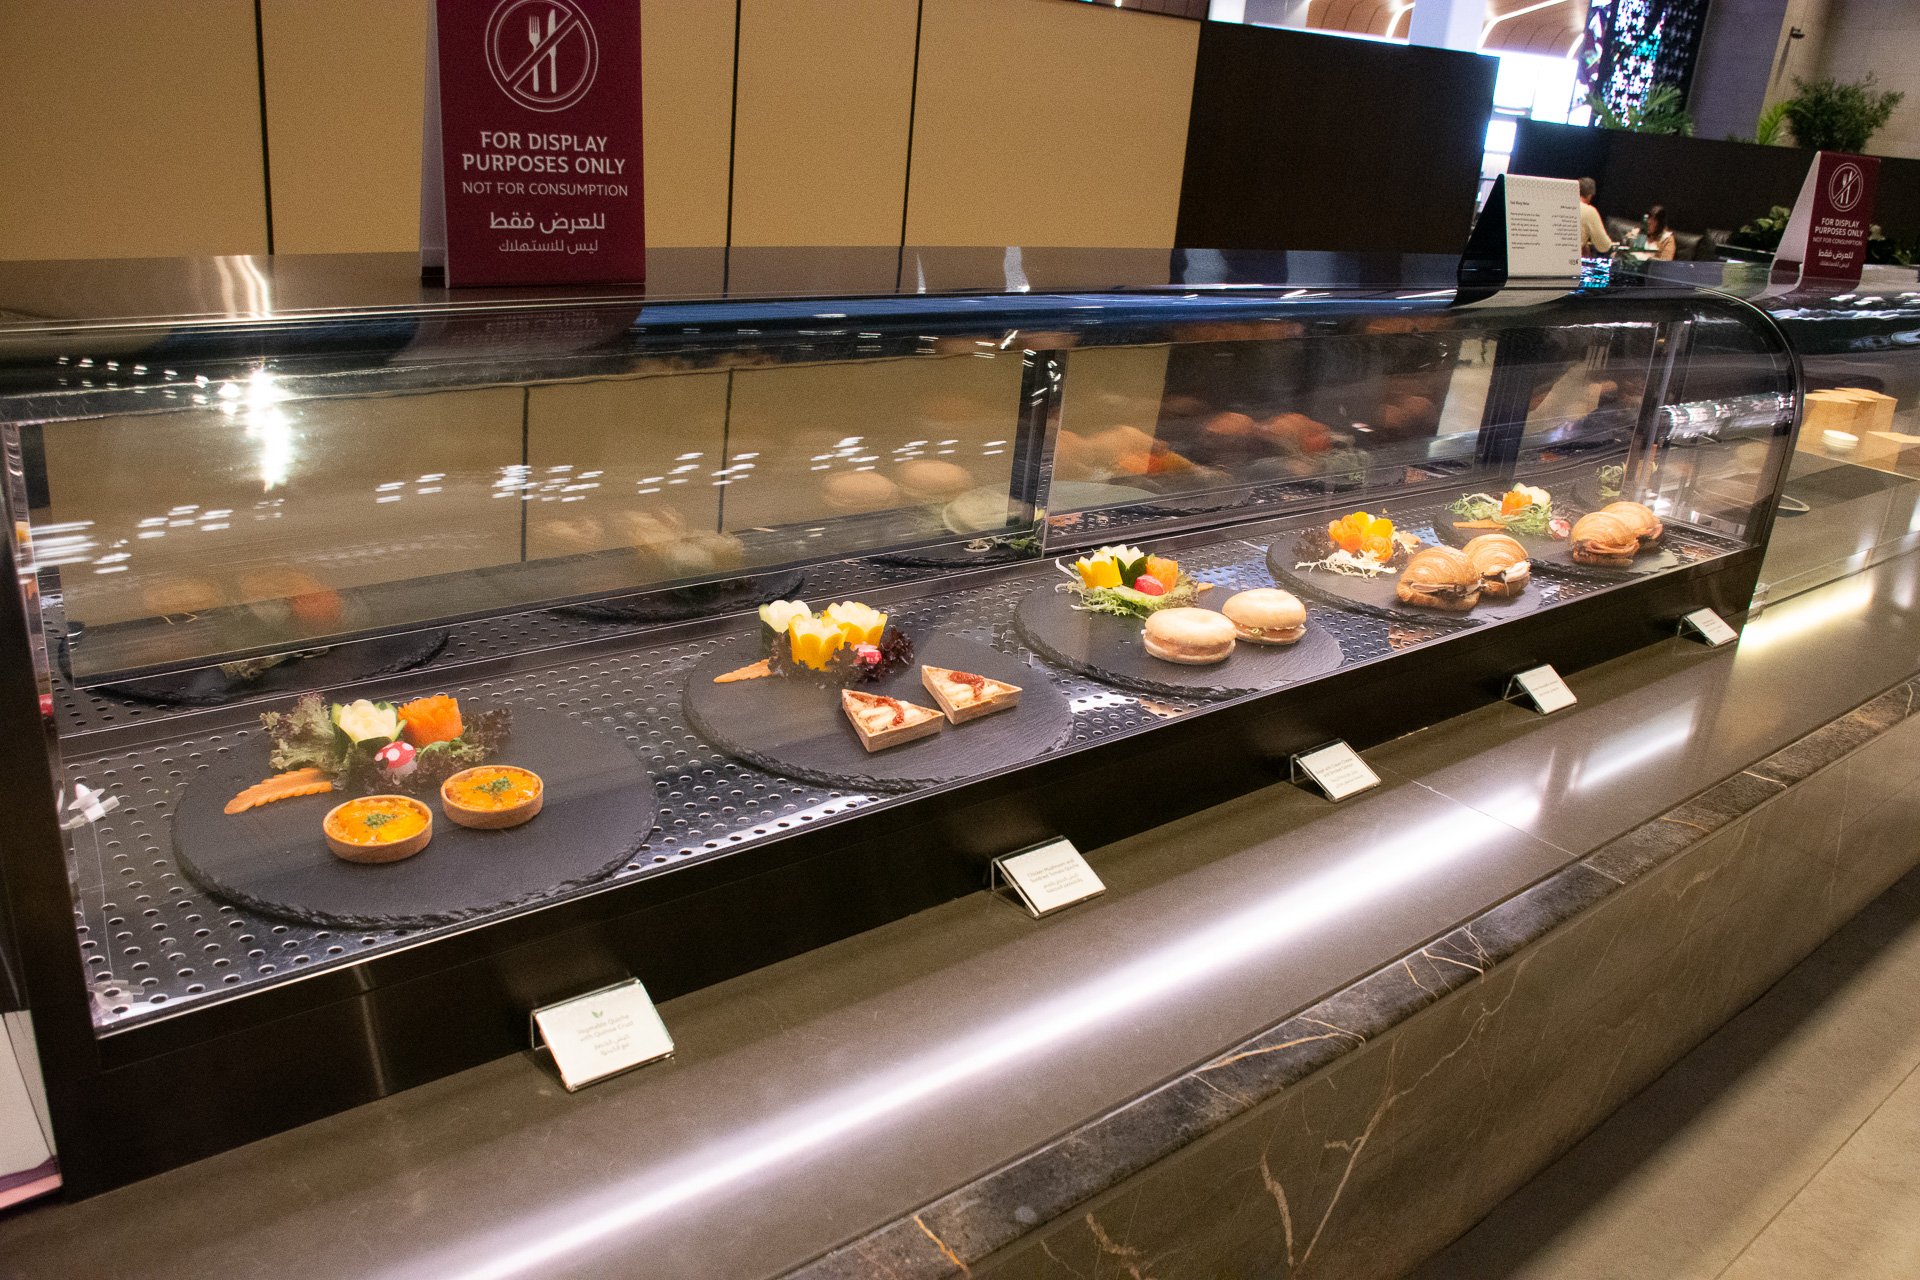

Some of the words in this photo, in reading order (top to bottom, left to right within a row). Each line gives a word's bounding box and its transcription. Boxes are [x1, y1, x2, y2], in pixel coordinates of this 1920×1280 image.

[480, 131, 521, 149] FOR
[528, 133, 607, 152] DISPLAY
[462, 154, 568, 173] PURPOSES
[575, 157, 625, 175] ONLY
[462, 182, 492, 194] NOT
[497, 182, 525, 195] FOR
[529, 183, 628, 196] CONSUMPTION
[490, 211, 535, 229] فقط
[540, 212, 605, 234] للعرض
[1835, 219, 1859, 228] DISPLAY
[1814, 226, 1846, 236] PURPOSES
[1847, 228, 1864, 237] ONLY
[499, 239, 564, 252] للاستهلاك
[567, 239, 598, 254] ليس
[1818, 248, 1832, 258] فقط
[1832, 250, 1853, 260] للعرض
